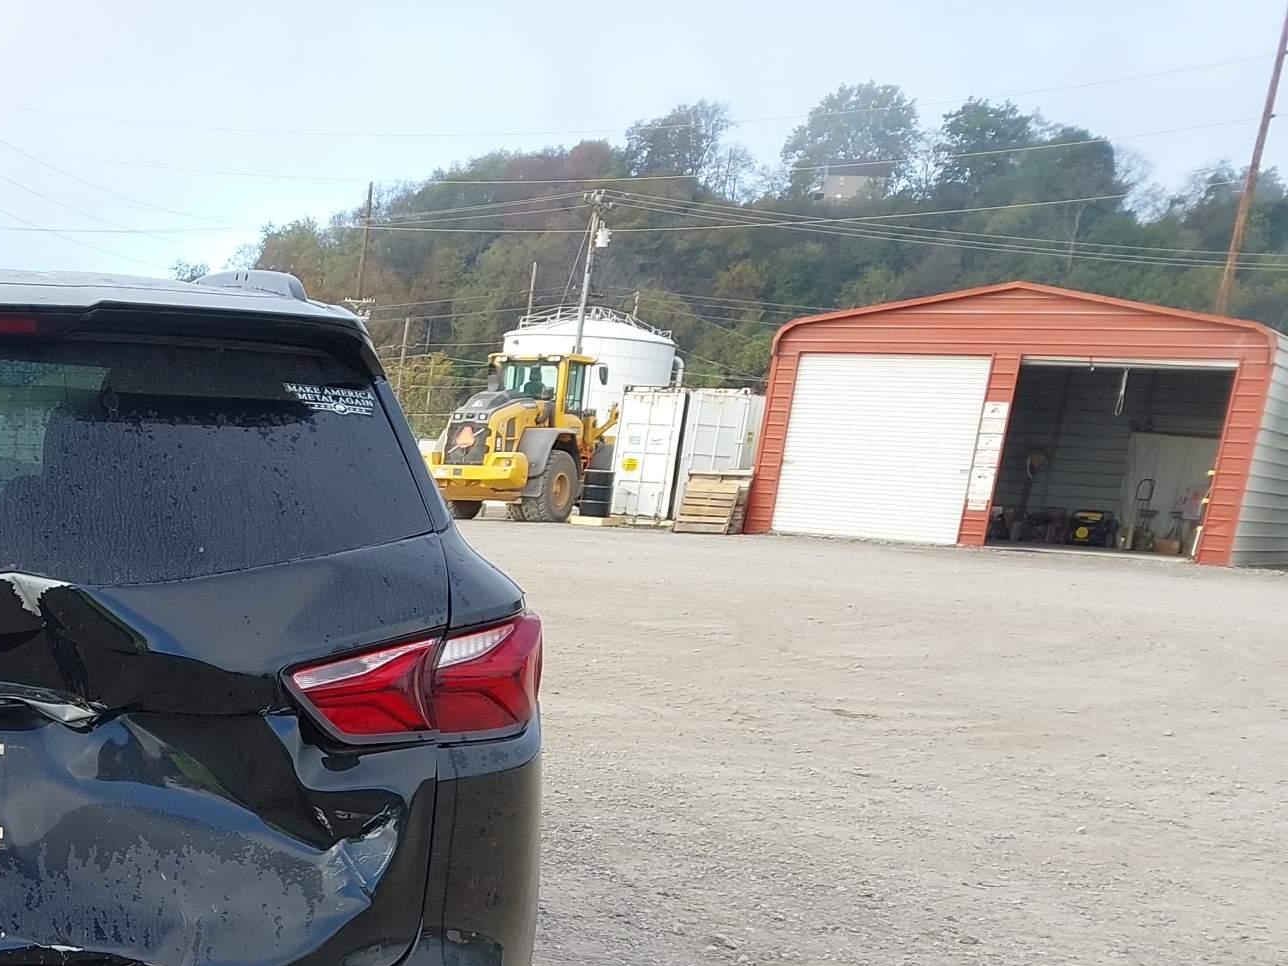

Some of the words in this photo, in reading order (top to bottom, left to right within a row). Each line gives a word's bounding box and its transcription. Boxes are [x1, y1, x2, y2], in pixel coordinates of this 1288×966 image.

[285, 383, 321, 394] MAKE
[323, 387, 374, 400] AMERICA
[296, 393, 337, 403] METAL
[338, 396, 374, 407] AGAIN
